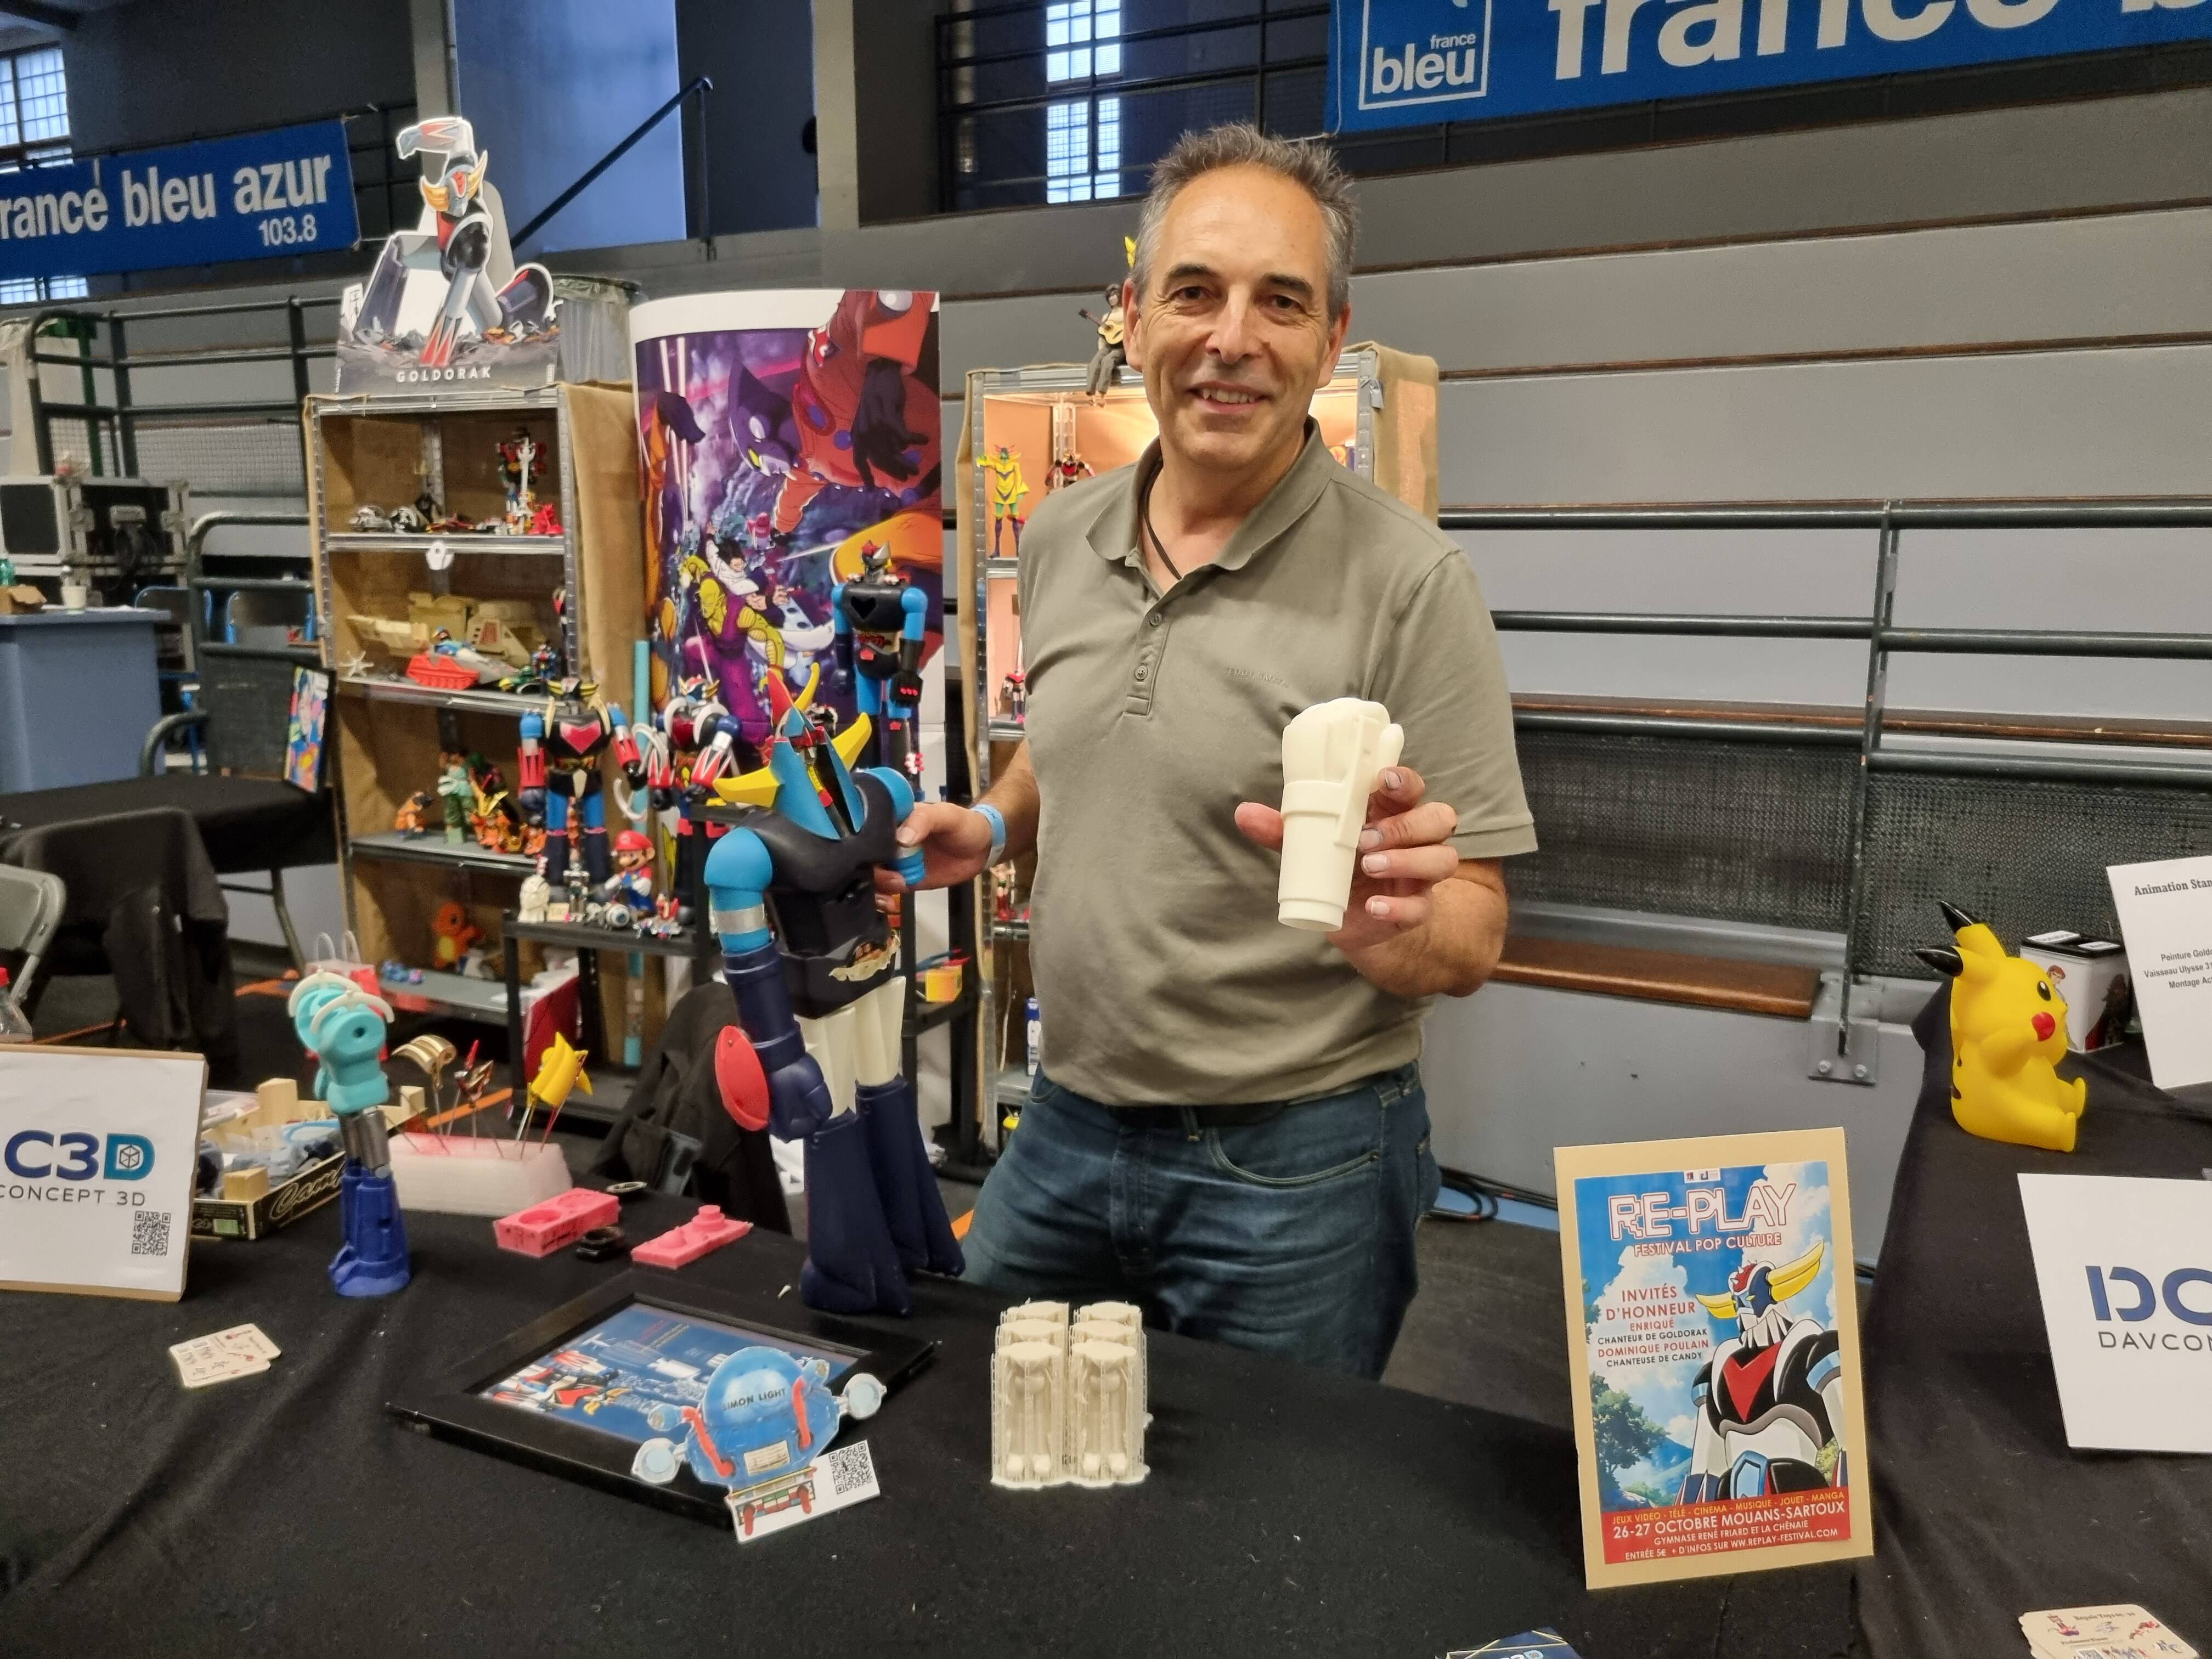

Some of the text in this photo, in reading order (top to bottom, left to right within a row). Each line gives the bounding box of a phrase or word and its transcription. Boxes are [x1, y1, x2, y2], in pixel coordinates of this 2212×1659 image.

[1430, 33, 1477, 49] france
[1372, 43, 1476, 94] bleu
[121, 165, 216, 228] bleu
[233, 154, 331, 215] azur
[258, 213, 317, 247] 103.8
[395, 365, 492, 383] GOLDORAK
[2134, 881, 2189, 896] Animation
[2160, 952, 2192, 962] Peinture
[2143, 967, 2178, 978] Vaisseau
[2179, 964, 2204, 974] Ulysse
[2168, 976, 2212, 989] Montage Ac
[4, 1130, 155, 1181] C3D
[117, 1190, 145, 1206] 3D
[1608, 1183, 1797, 1241] RE-PLAY
[1633, 1233, 1782, 1257] FESTIVAL POP CULTURE
[1622, 1283, 1677, 1302] INVITÉS
[1606, 1301, 1696, 1321] D'HONNEUR
[1630, 1318, 1674, 1331] ENRIQUÉ
[1598, 1334, 1643, 1345] CHANTEUR
[1659, 1328, 1708, 1339] GOLDORAK
[1598, 1339, 1709, 1357] DOMINIQUE POULAIN
[1606, 1356, 1656, 1367] CHANTEUSE
[1672, 1352, 1703, 1361] CANDY
[723, 1388, 786, 1411] SIMON LIGHT
[1612, 1515, 1633, 1525] JEUX
[1635, 1512, 1661, 1522] VIDEO
[1669, 1507, 1686, 1519] TÉLÉ
[1694, 1505, 1728, 1515] CINEMA
[1735, 1499, 1772, 1510] MUSIQUE
[1780, 1496, 1804, 1506] JOUET
[1812, 1491, 1845, 1502] MANGA
[1613, 1501, 1846, 1539] 26-27 OCTOBRE MOUANS-SARTOUX
[1654, 1520, 1809, 1545] GYMNASE RENÉ FRIARD ET LA CHÊNAIE
[1625, 1548, 1654, 1560] ENTRÉE
[1656, 1548, 1667, 1557] 5€
[1679, 1543, 1712, 1554] D'INFOS
[1714, 1541, 1729, 1550] SUR
[1730, 1528, 1838, 1548] WW.REPLAY-FESTIVAL.COM
